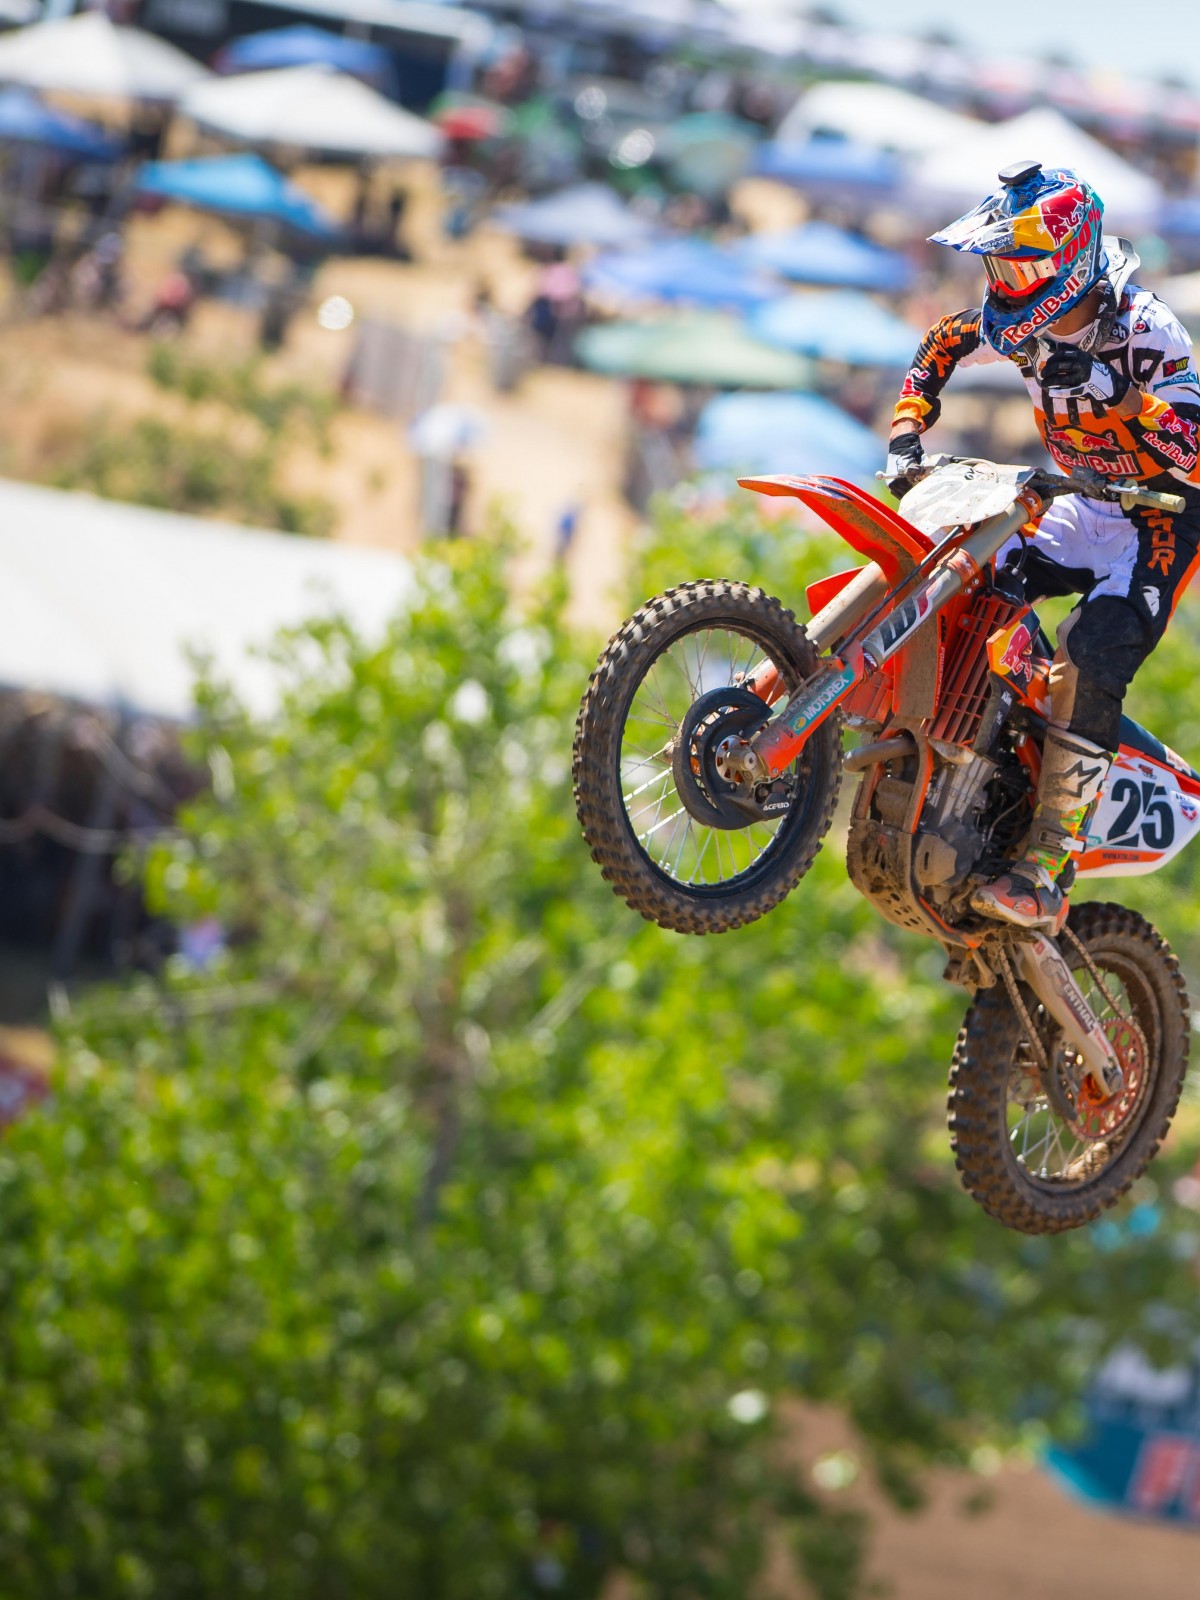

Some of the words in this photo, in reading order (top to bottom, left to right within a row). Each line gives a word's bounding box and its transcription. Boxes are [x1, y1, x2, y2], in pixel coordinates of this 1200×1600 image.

[1001, 305, 1050, 345] Red
[1040, 274, 1081, 316] Bull
[1046, 441, 1087, 467] Red
[1086, 453, 1139, 475] Bull
[1141, 431, 1176, 455] Red
[1168, 445, 1198, 471] Bull
[802, 674, 849, 720] MOTOREX
[1106, 777, 1175, 849] 25
[1063, 982, 1096, 1030] ENTHAL
